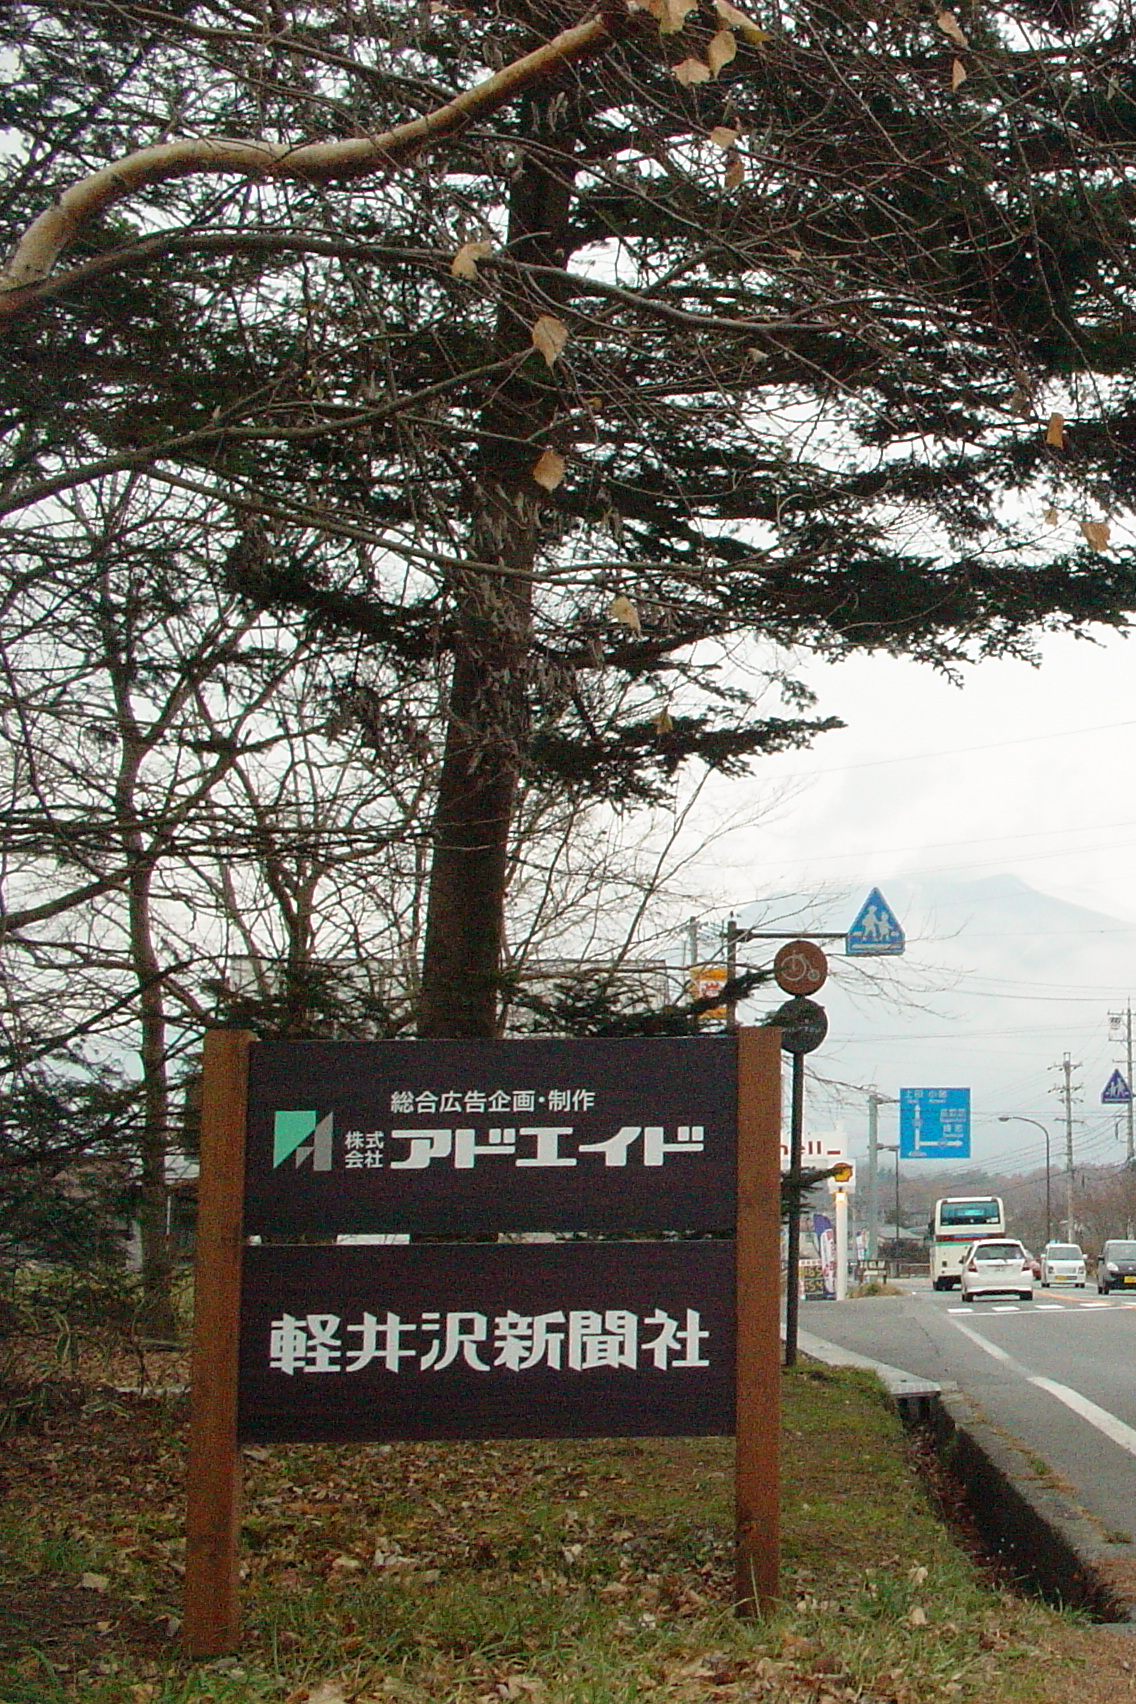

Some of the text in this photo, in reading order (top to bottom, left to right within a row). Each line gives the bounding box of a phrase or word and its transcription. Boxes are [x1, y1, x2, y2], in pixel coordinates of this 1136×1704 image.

[390, 1089, 595, 1114] 総合広告企画・制作
[344, 1130, 384, 1150] 株式
[390, 1126, 705, 1170] アドエイド
[344, 1150, 384, 1169] 会社
[269, 1308, 710, 1376] 軽井沢新聞社
